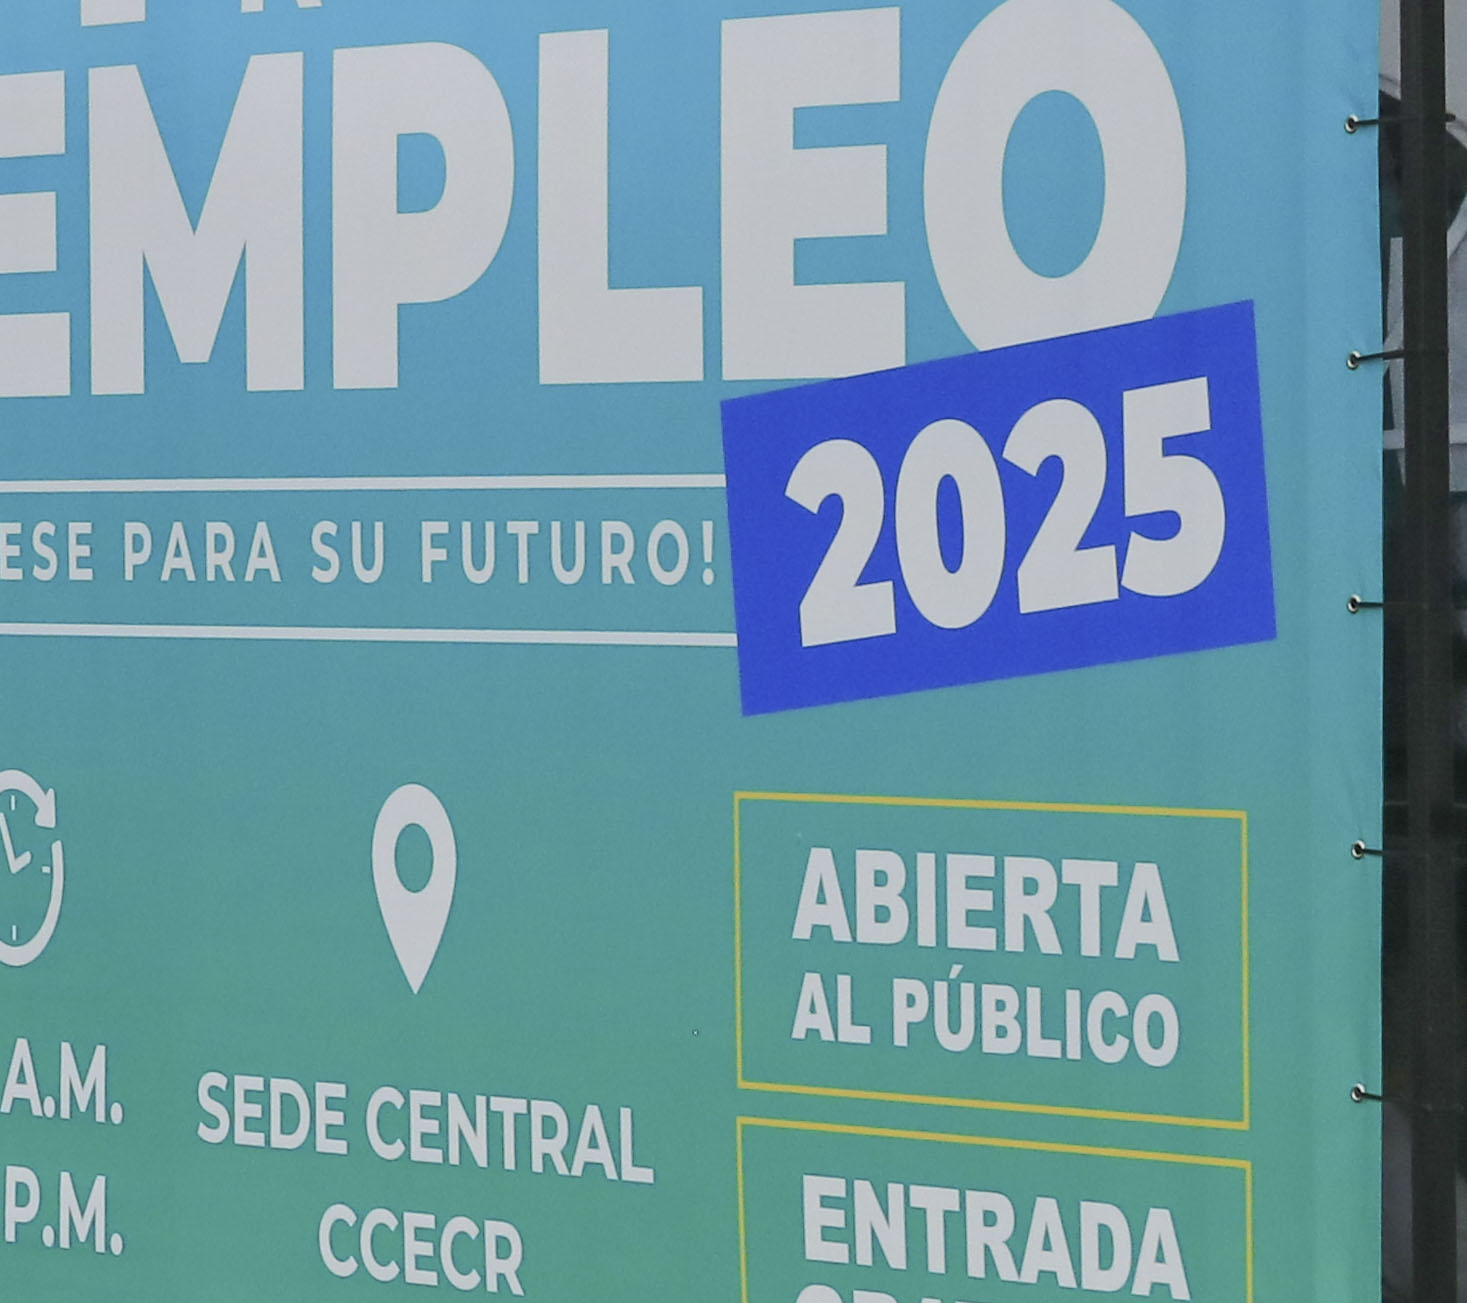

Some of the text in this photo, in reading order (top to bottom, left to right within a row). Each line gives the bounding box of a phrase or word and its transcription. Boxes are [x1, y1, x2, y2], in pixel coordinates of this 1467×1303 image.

[123, 520, 282, 584] PARA
[310, 518, 386, 585] SU
[420, 518, 719, 587] FUTURO!
[784, 375, 1226, 648] 2025
[791, 846, 1181, 963] ABIERTA
[791, 963, 1181, 1068] AL PÚBLICO
[0, 1036, 124, 1125] A.M.
[197, 1071, 655, 1184] SEDE CENTRAL
[3, 1164, 124, 1256] P.M.
[318, 1203, 525, 1296] CCECR
[802, 1173, 1192, 1302] ENTRADA
